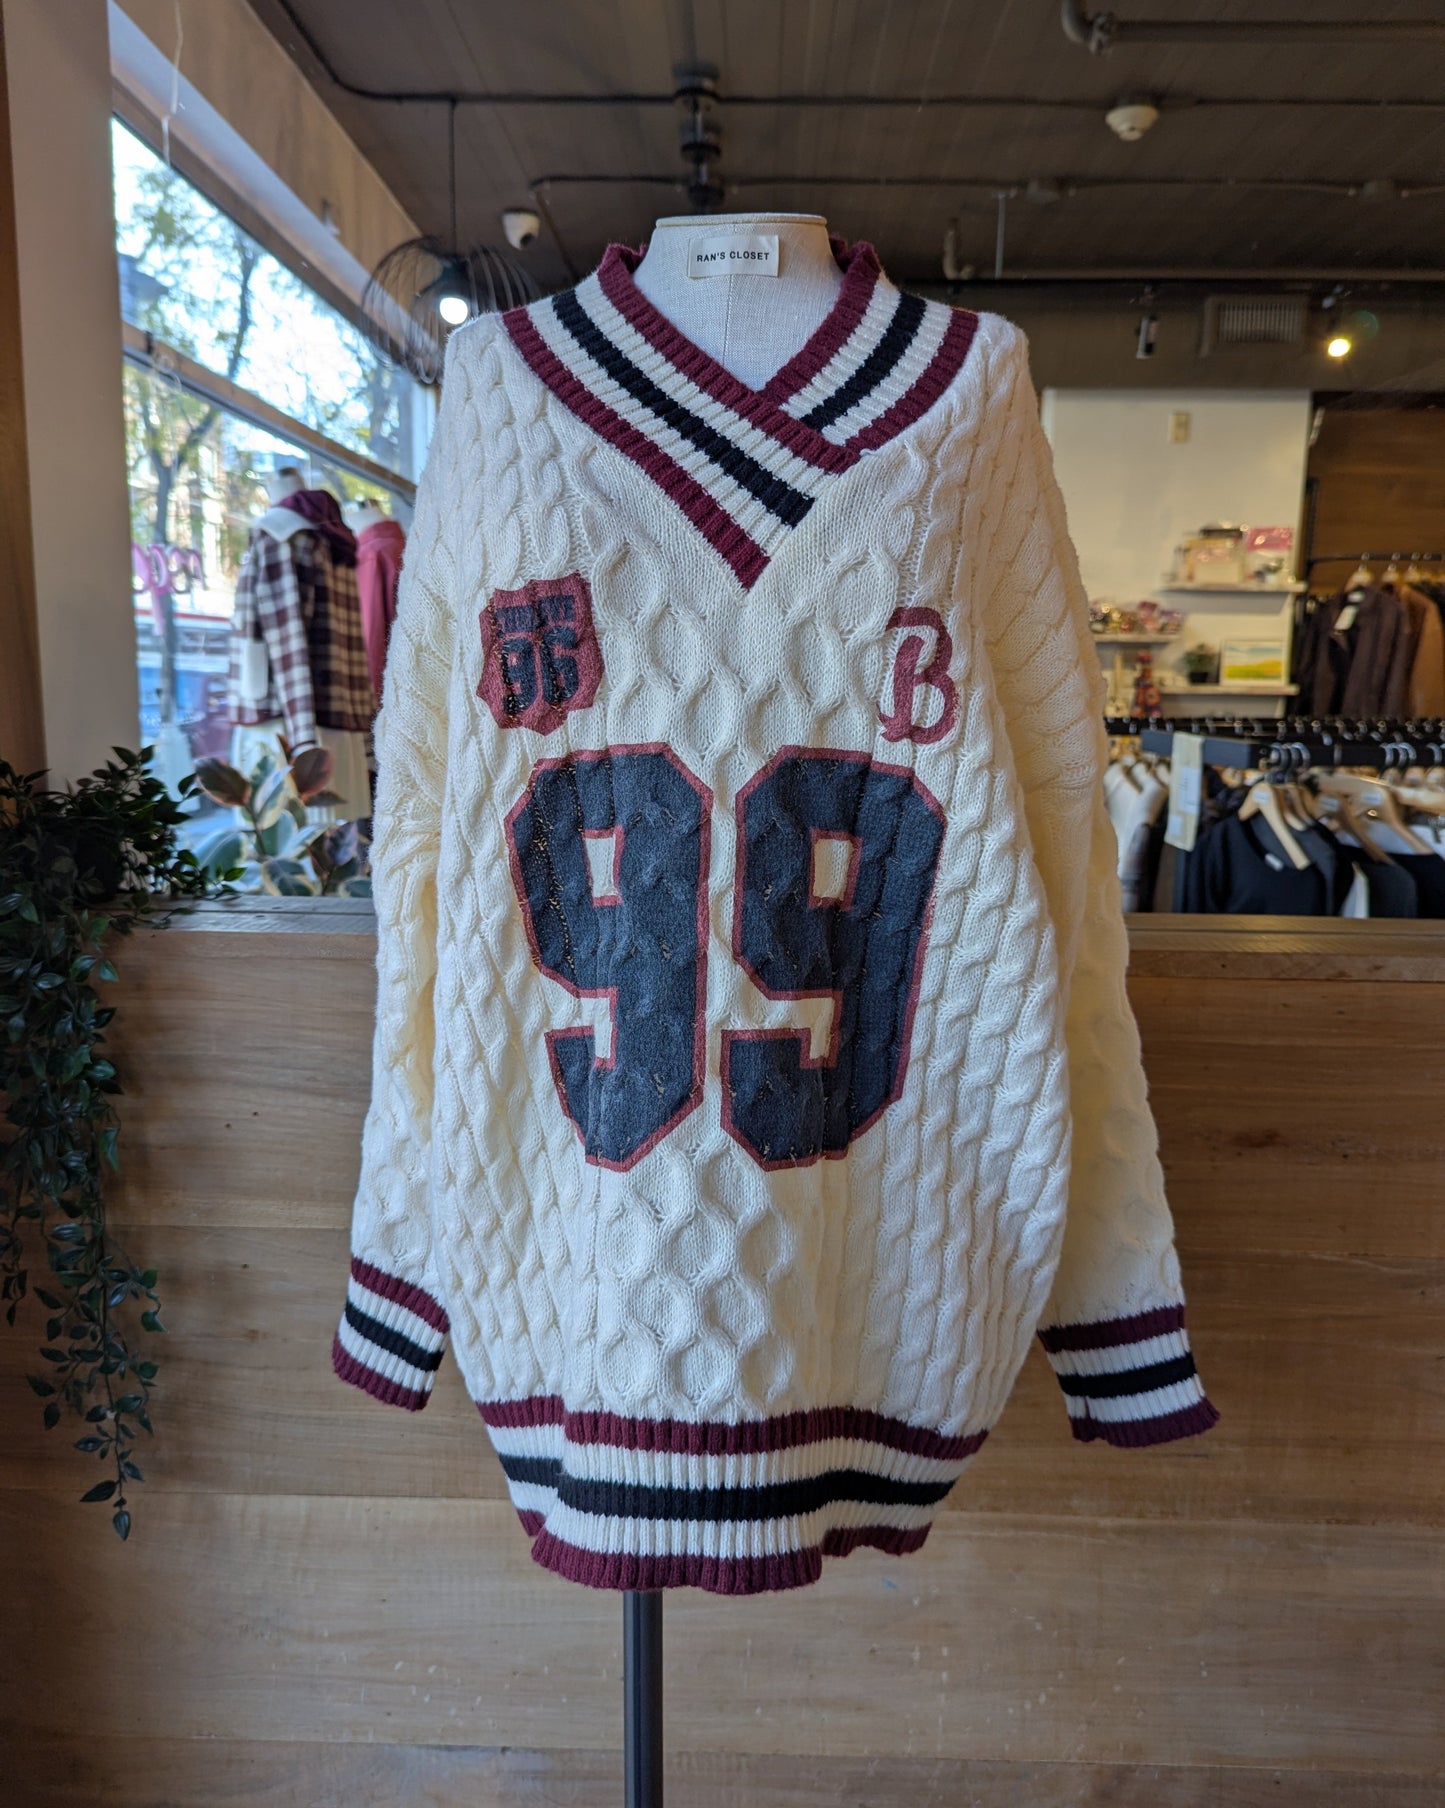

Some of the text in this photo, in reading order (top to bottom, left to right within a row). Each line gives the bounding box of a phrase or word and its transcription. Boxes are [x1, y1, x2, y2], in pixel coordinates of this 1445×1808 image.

[696, 250, 770, 262] RAN'S CLOSET
[501, 624, 580, 716] 96
[876, 606, 959, 745] B
[504, 742, 948, 1173] 99
